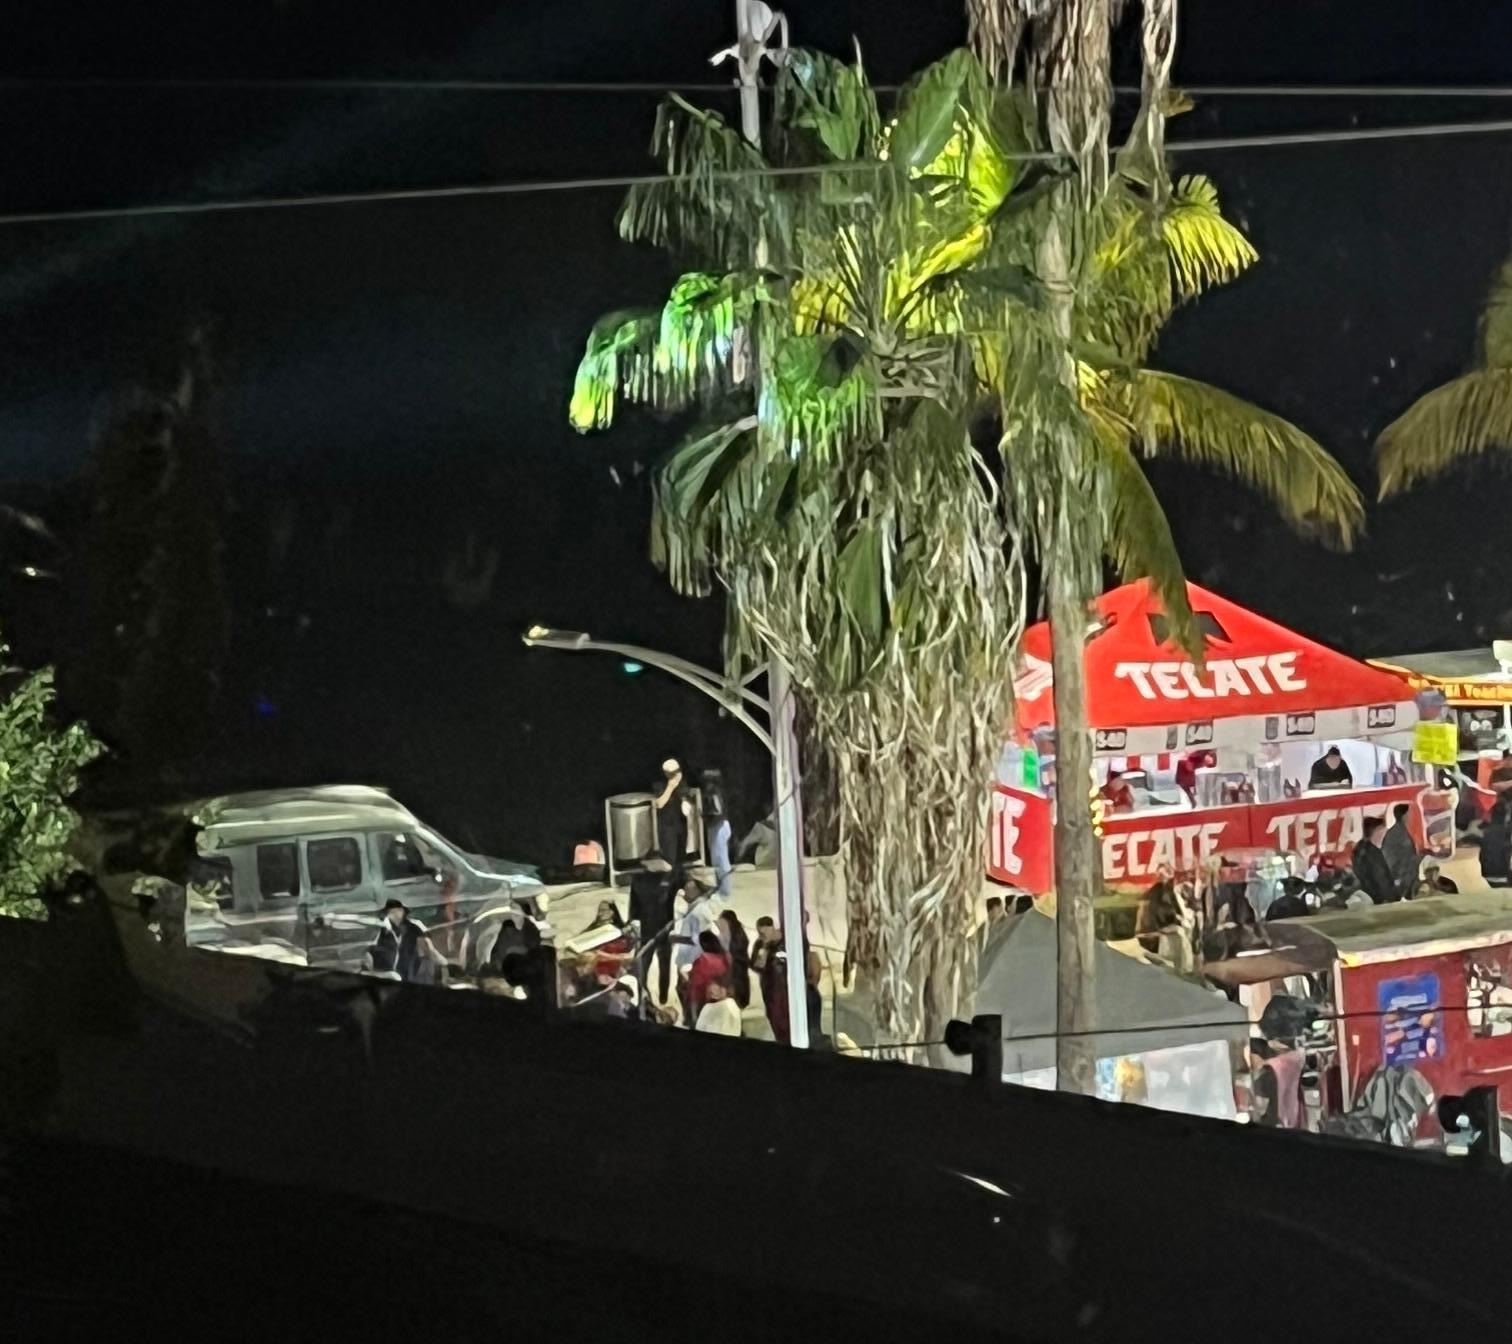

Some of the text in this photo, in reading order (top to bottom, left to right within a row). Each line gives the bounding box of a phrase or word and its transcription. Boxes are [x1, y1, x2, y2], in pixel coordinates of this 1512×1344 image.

[1114, 651, 1308, 700] TECATE
[1101, 821, 1229, 880] ECATE
[1265, 801, 1413, 854] TECA
